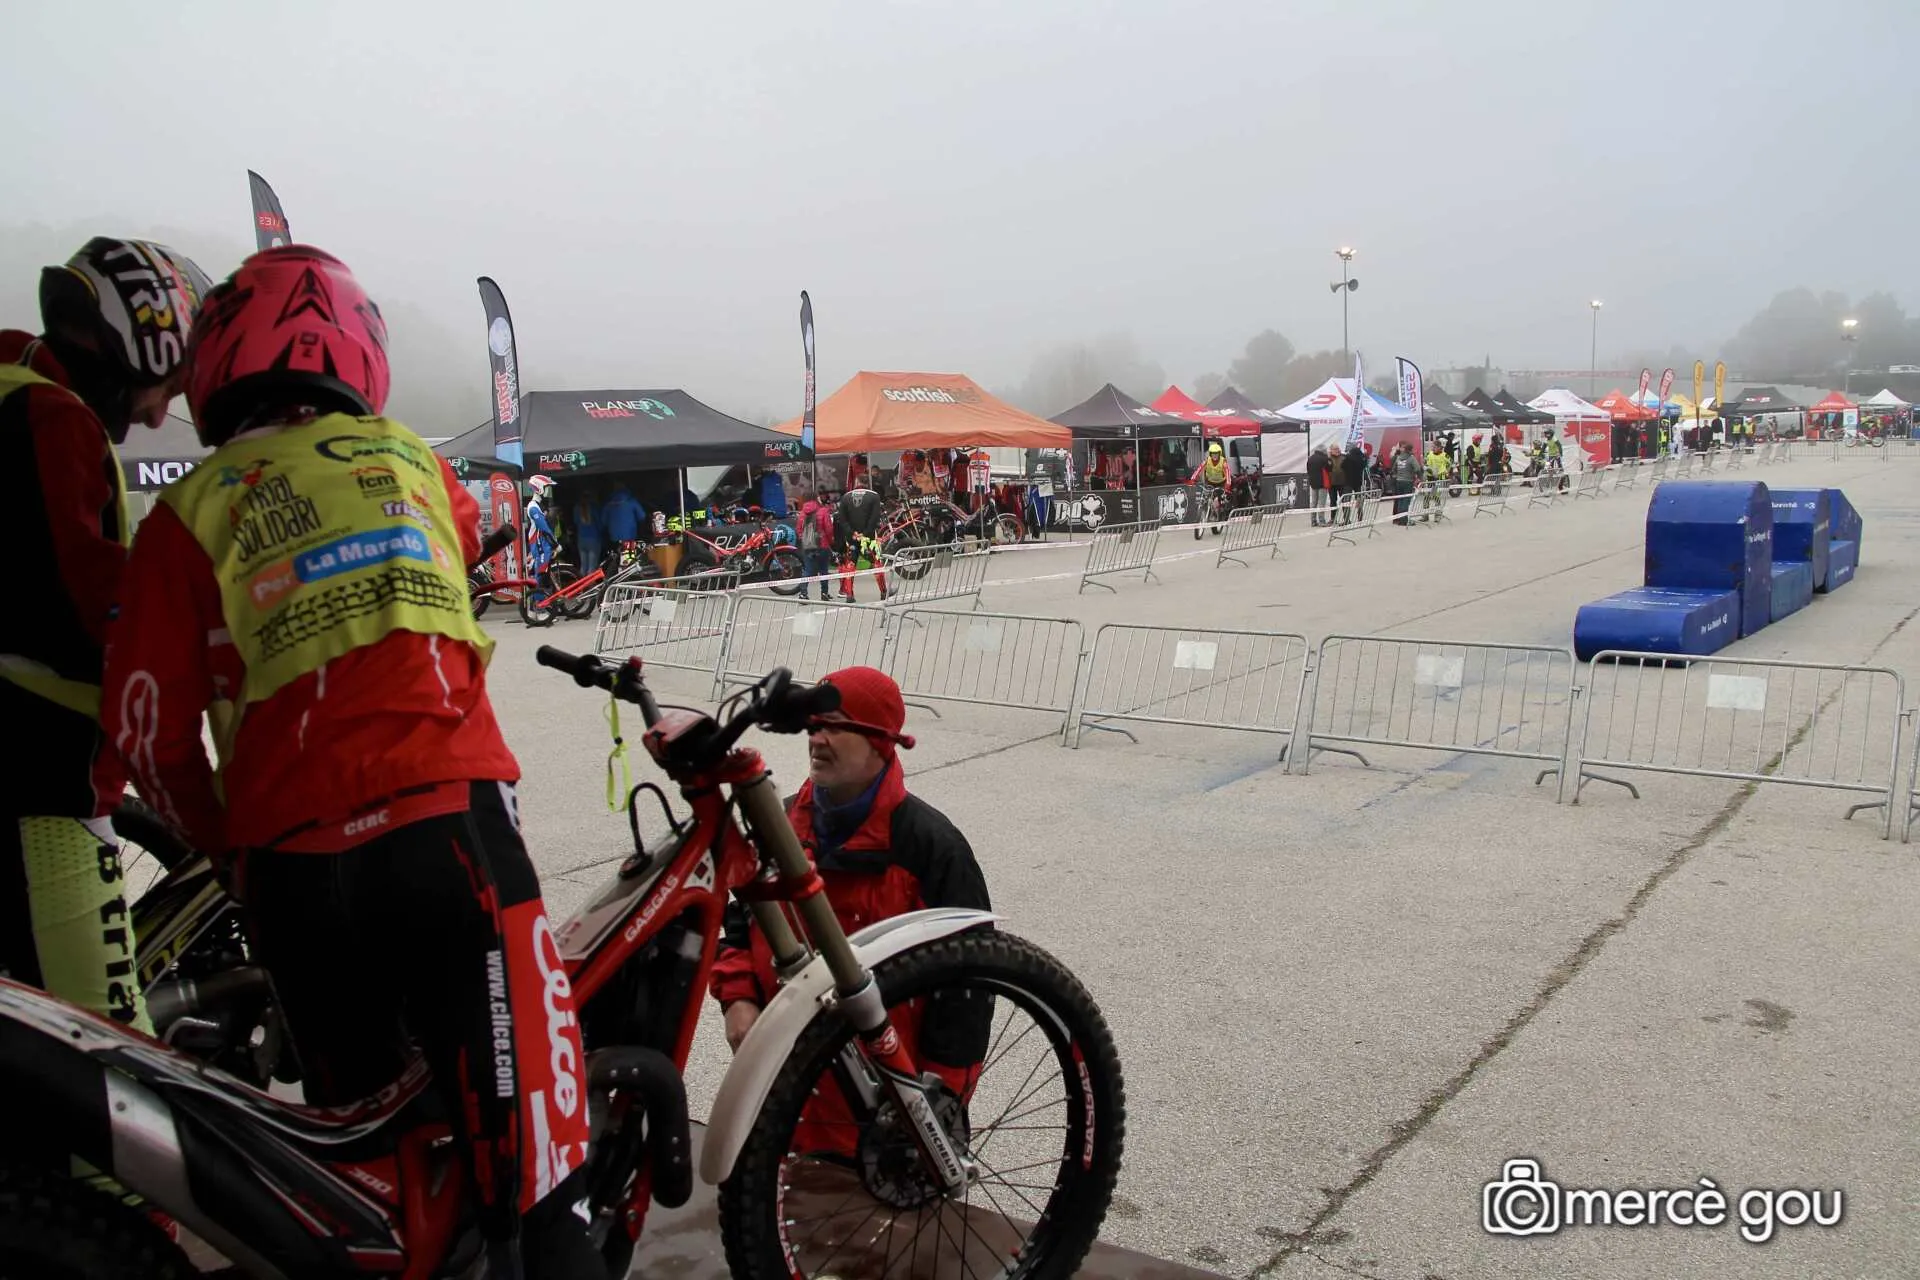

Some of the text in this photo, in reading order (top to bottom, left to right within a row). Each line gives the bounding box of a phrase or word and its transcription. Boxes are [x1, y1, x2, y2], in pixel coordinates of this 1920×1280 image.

[581, 399, 655, 413] PLANET
[138, 461, 202, 485] NO
[540, 453, 577, 464] PLANET
[357, 474, 396, 489] fcm
[305, 552, 336, 572] La
[339, 533, 424, 563] Marató
[624, 872, 679, 942] GASGAS
[486, 949, 516, 1098] www.clice.com
[1074, 1060, 1096, 1163] GASGAS
[925, 1121, 958, 1178] MICHELIN
[352, 1167, 394, 1194] 300
